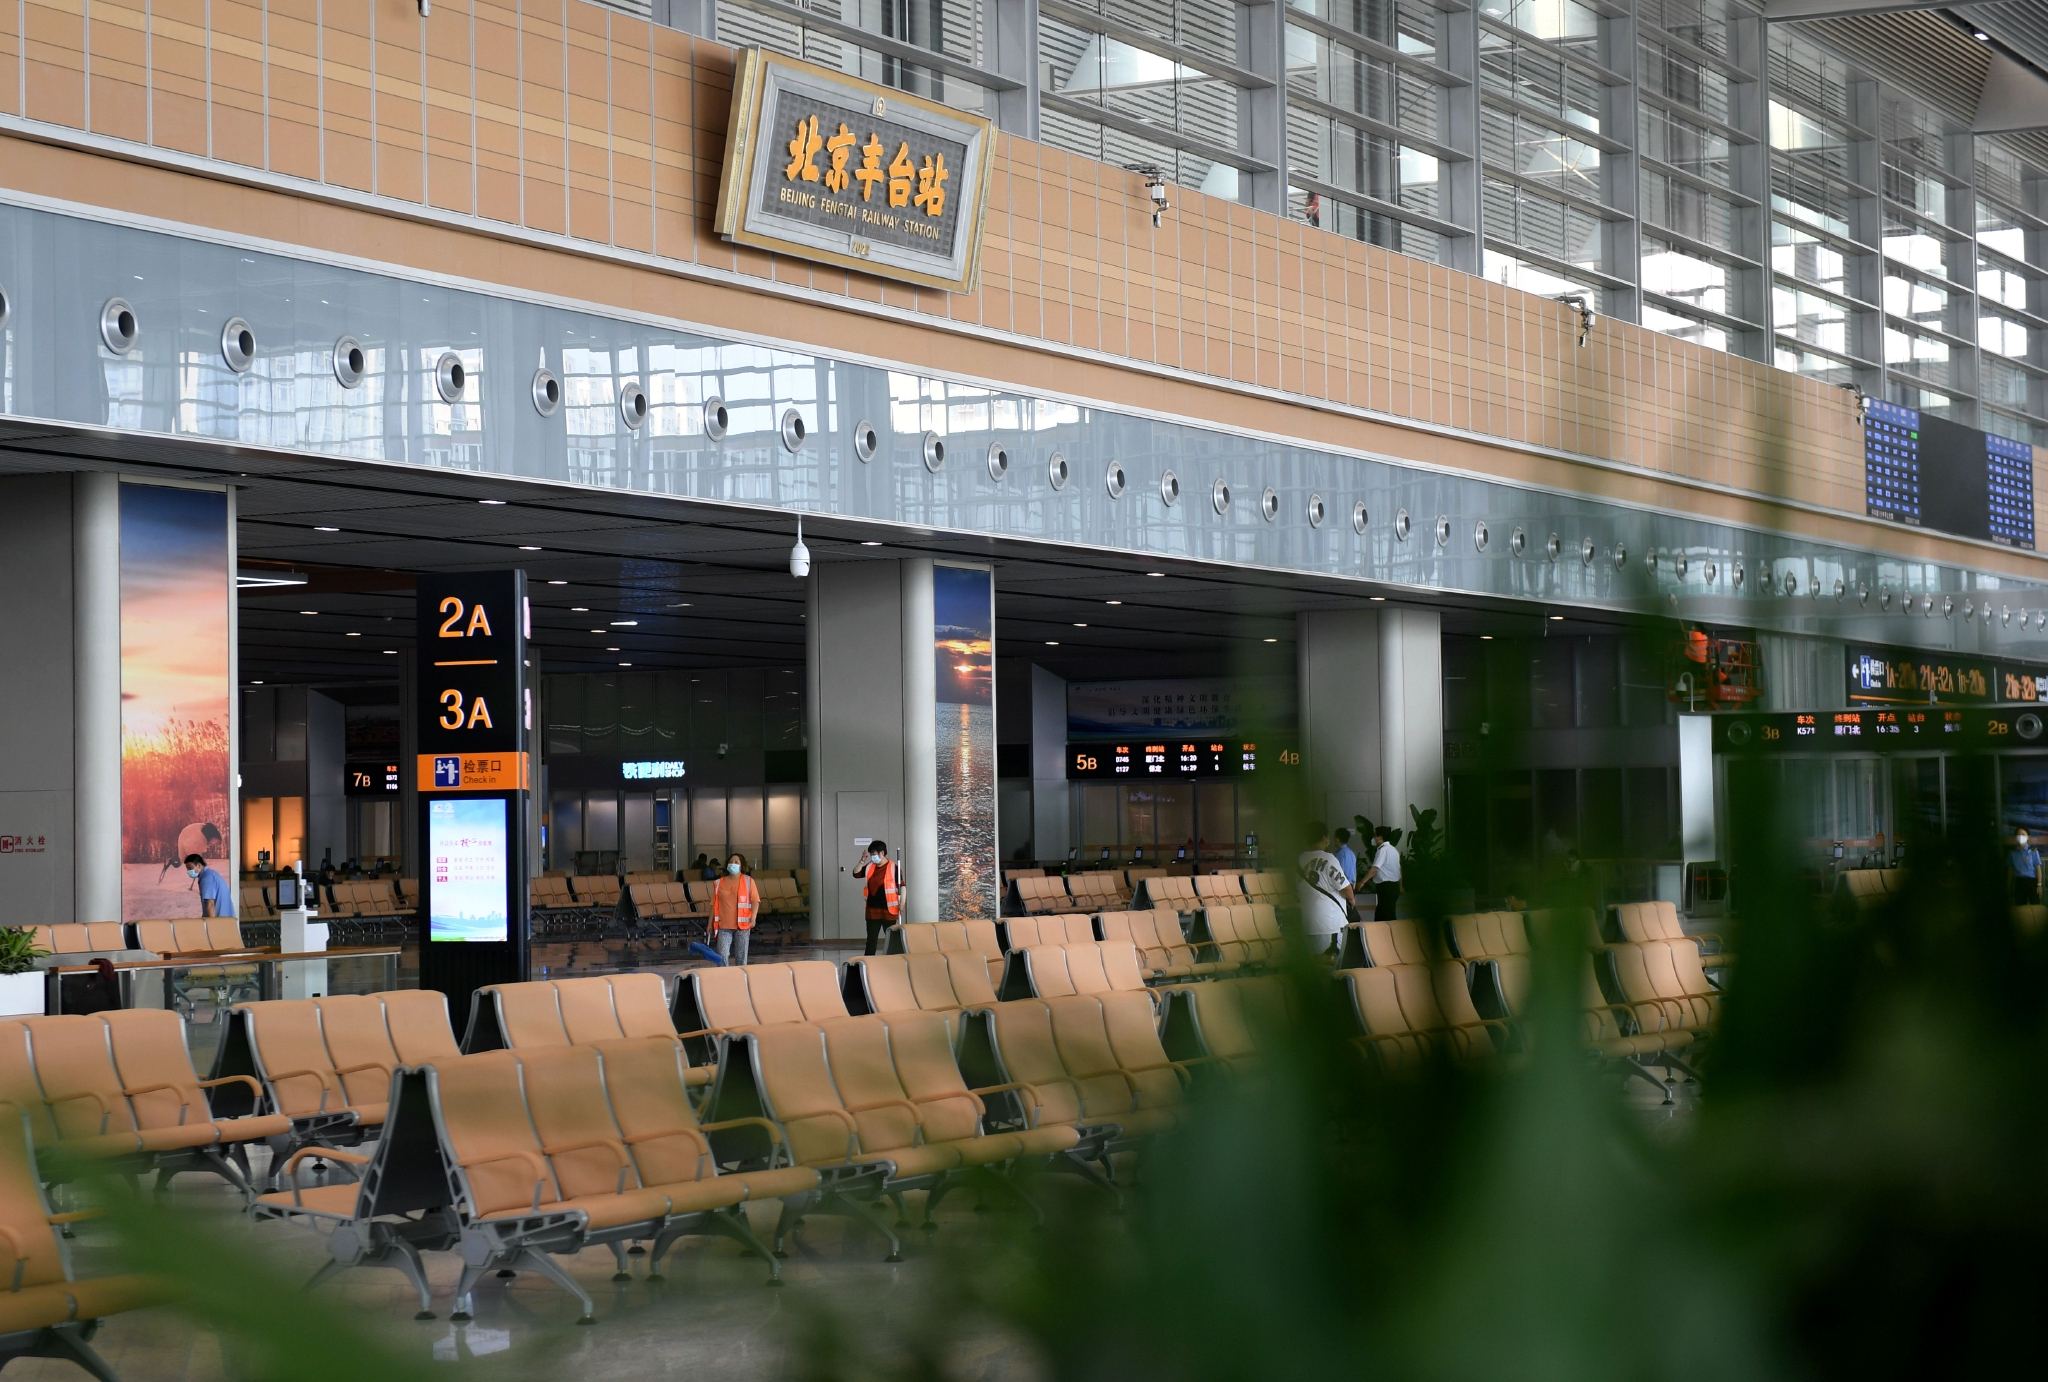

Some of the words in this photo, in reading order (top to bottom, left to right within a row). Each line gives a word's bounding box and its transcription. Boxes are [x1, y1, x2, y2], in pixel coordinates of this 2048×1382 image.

[787, 115, 949, 217] 北京丰台站
[780, 187, 815, 209] BEIJING
[821, 197, 857, 220] FENGTAI
[861, 208, 900, 229] RAILWAY
[904, 219, 940, 240] STATION
[438, 596, 492, 638] 2A
[1920, 664, 1954, 693] 21A-32A
[439, 688, 493, 730] 3A
[1797, 715, 1815, 724] 车次
[1834, 714, 1861, 723] 终到站
[1877, 713, 1897, 723] 开点
[1907, 713, 1925, 722] 站台
[1761, 725, 1780, 740] 3B
[1797, 727, 1815, 735] K571
[1834, 725, 1861, 735] 厦门北
[1913, 725, 1919, 733] 3
[1988, 720, 2008, 735] 2B
[1182, 744, 1195, 752] 开点
[1210, 744, 1224, 752] 站台
[1076, 754, 1098, 770] 5B
[1242, 753, 1256, 761] 候车
[1279, 749, 1300, 765] 4B
[463, 759, 502, 774] 检票口
[664, 769, 686, 778] SHOP
[1242, 763, 1256, 771] 候车
[353, 772, 371, 787] 7B
[463, 775, 487, 784] Check
[488, 776, 497, 784] in
[14, 836, 46, 846] 消火栓
